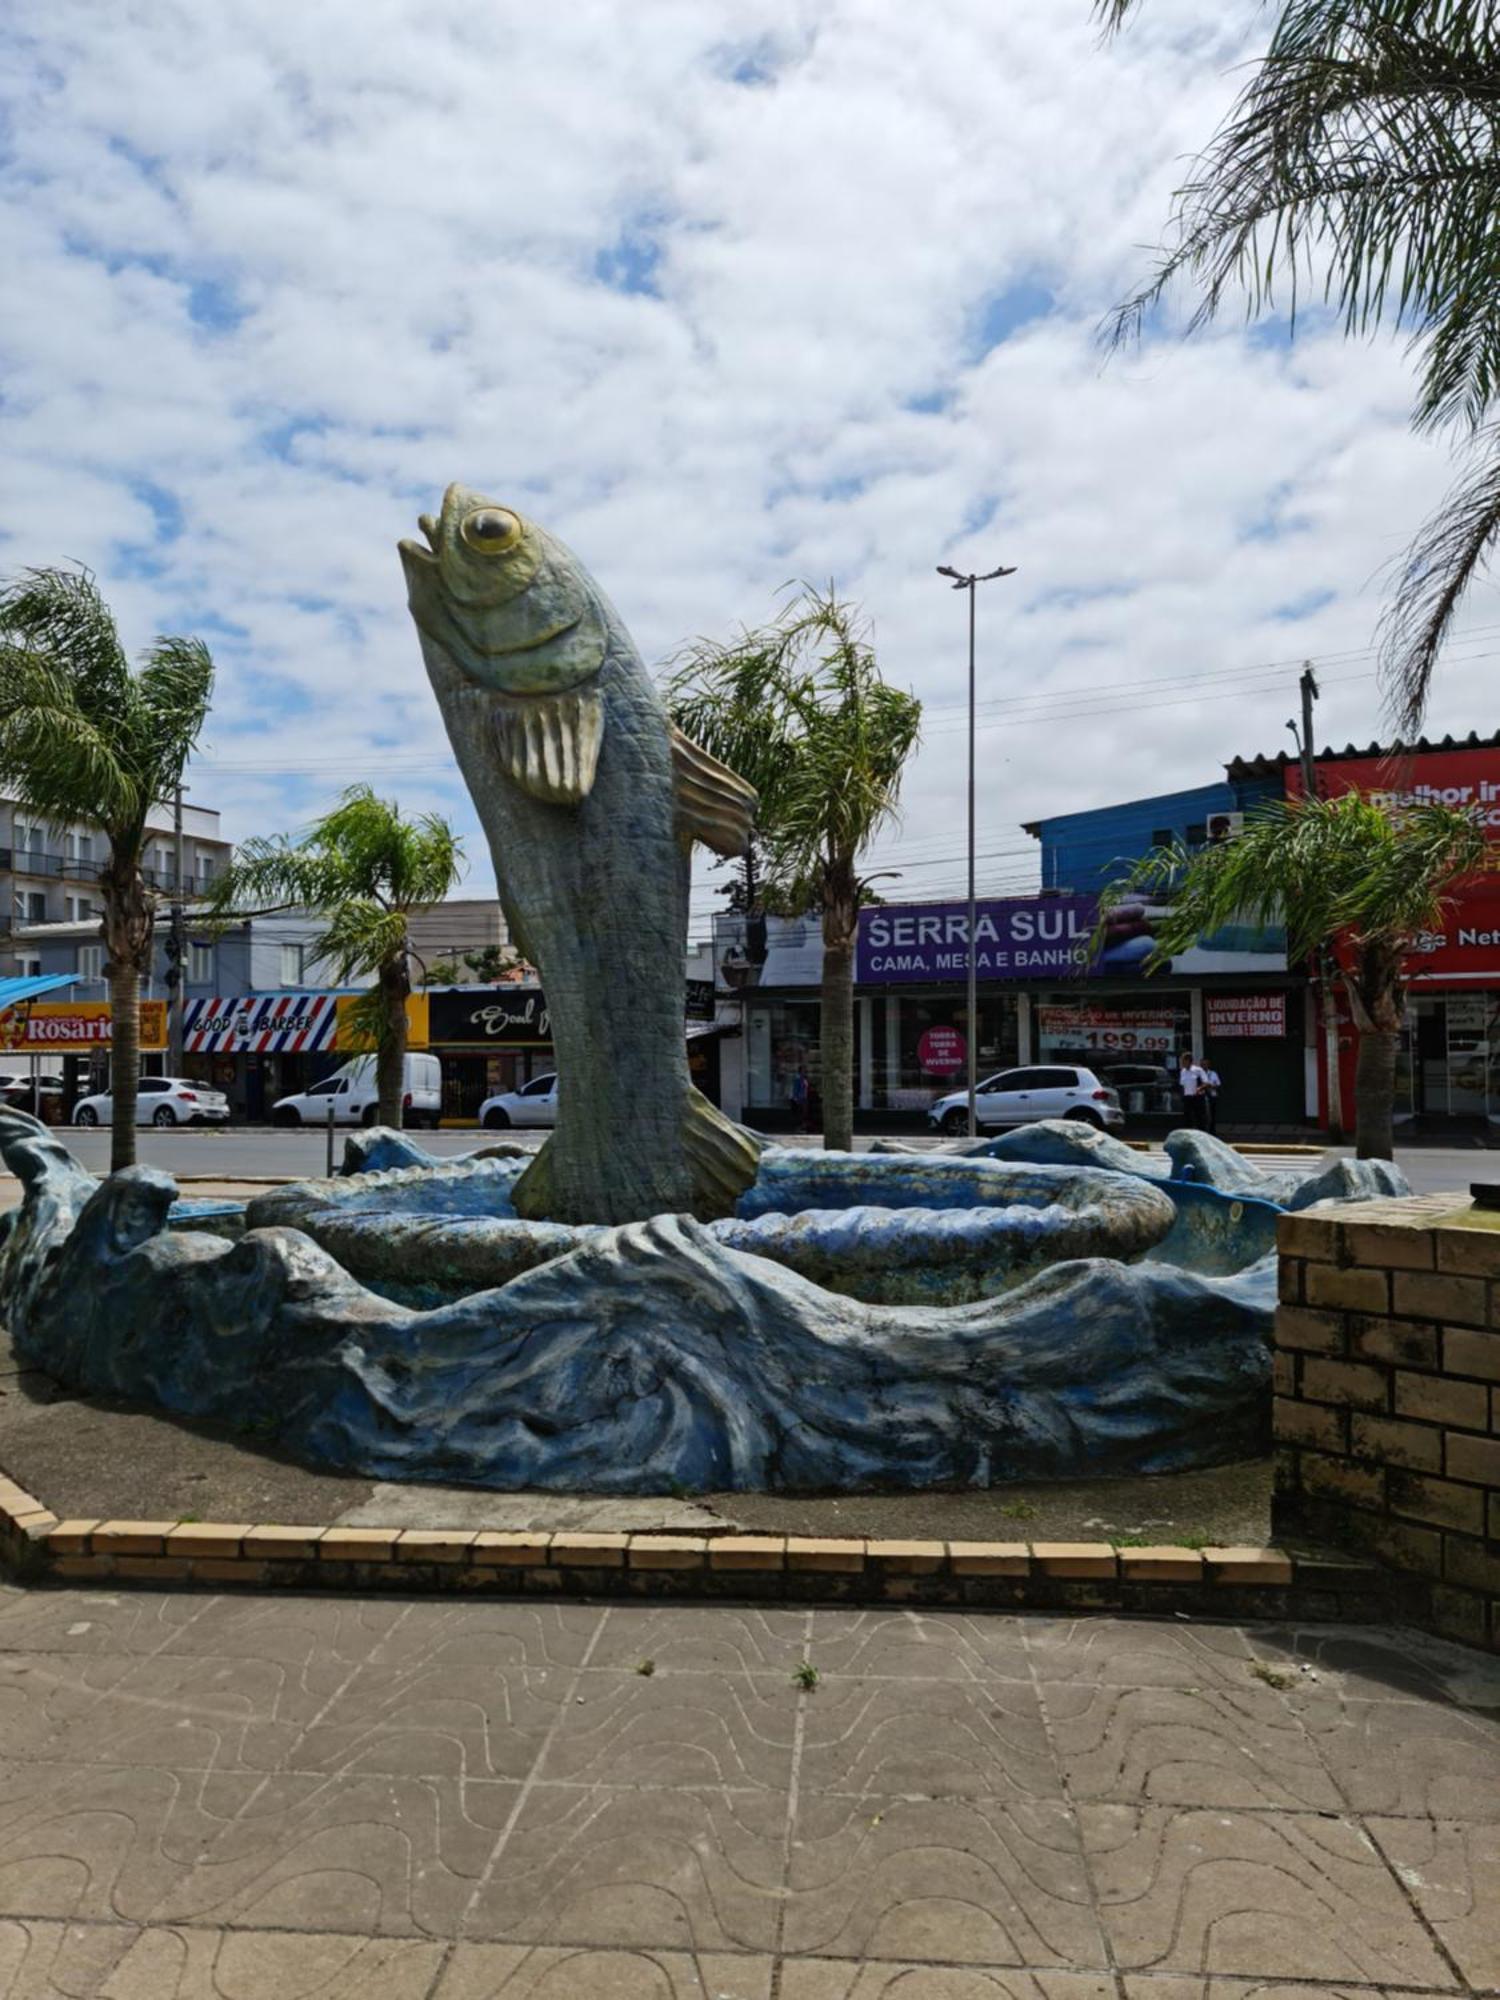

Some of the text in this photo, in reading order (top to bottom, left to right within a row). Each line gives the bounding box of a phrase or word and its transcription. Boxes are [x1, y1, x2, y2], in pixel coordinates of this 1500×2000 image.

[868, 910, 1091, 947] SERRA SUL
[870, 955, 930, 971] CAMA,
[996, 952, 1009, 966] E
[1015, 950, 1088, 967] BANHO
[1269, 997, 1283, 1009] DE
[193, 1015, 315, 1032] GOOD BARBER
[1209, 1010, 1283, 1023] INVERNO
